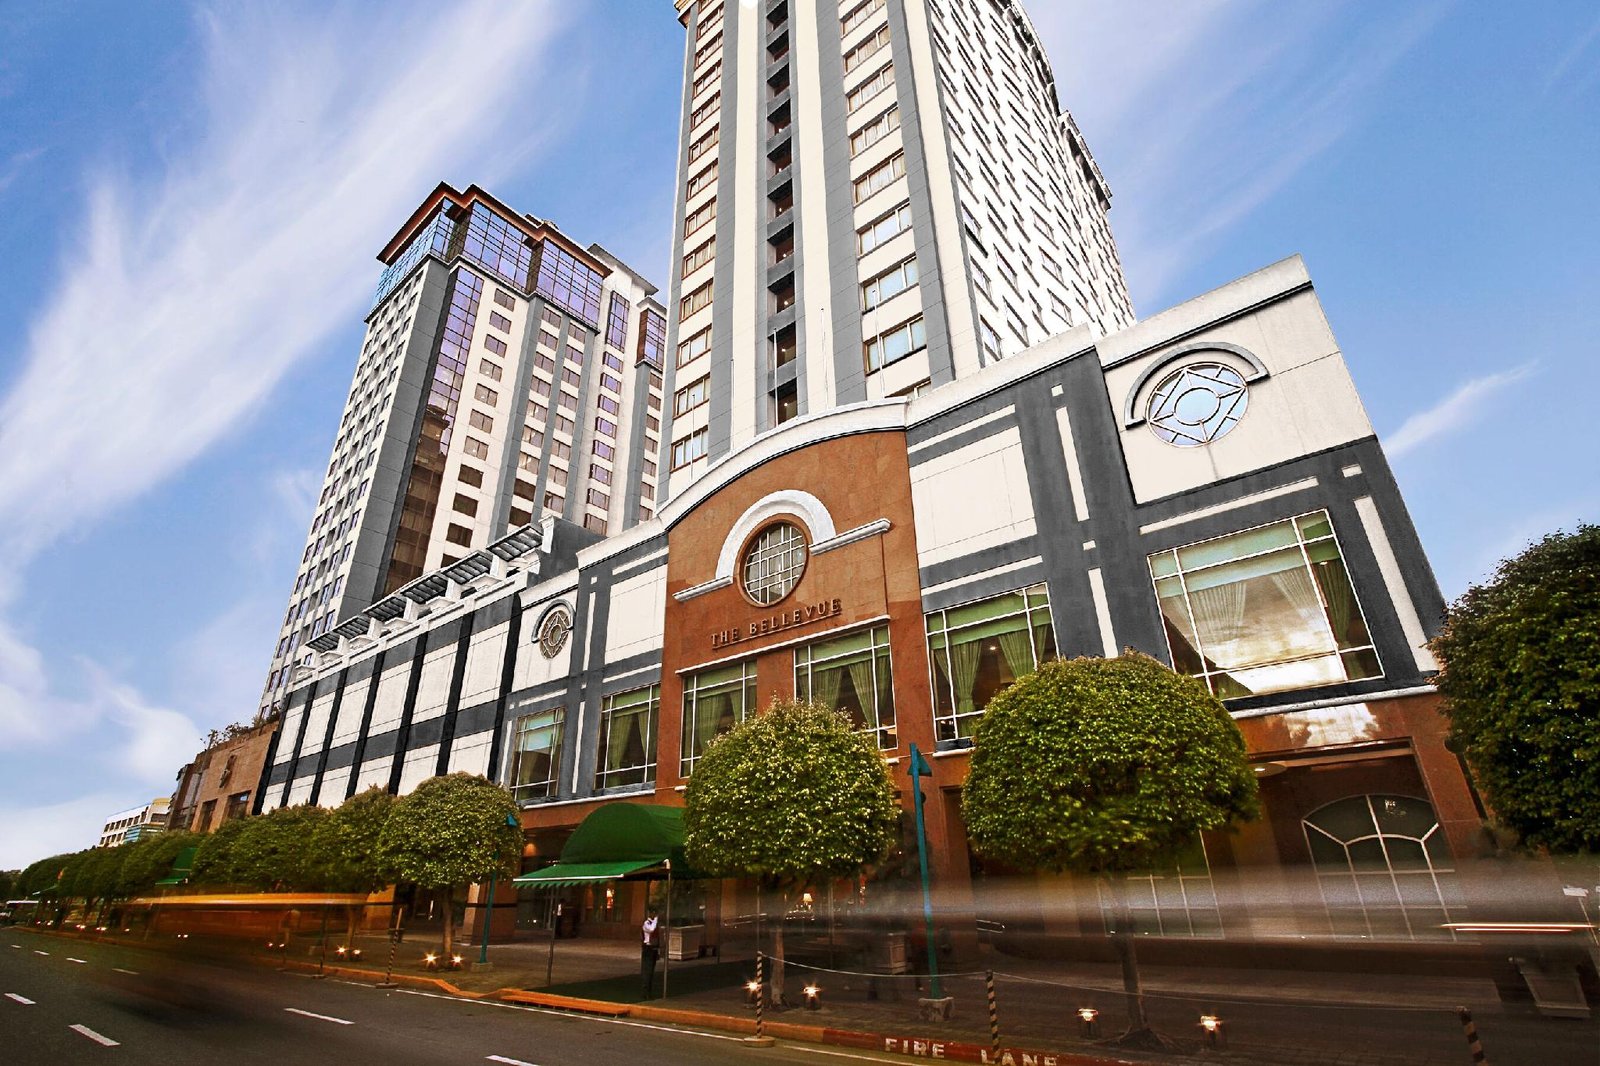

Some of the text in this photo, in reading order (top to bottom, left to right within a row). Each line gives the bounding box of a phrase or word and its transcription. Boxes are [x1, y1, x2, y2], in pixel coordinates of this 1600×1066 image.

[711, 599, 842, 646] THE BELLEVUE
[885, 1037, 945, 1058] FIRE
